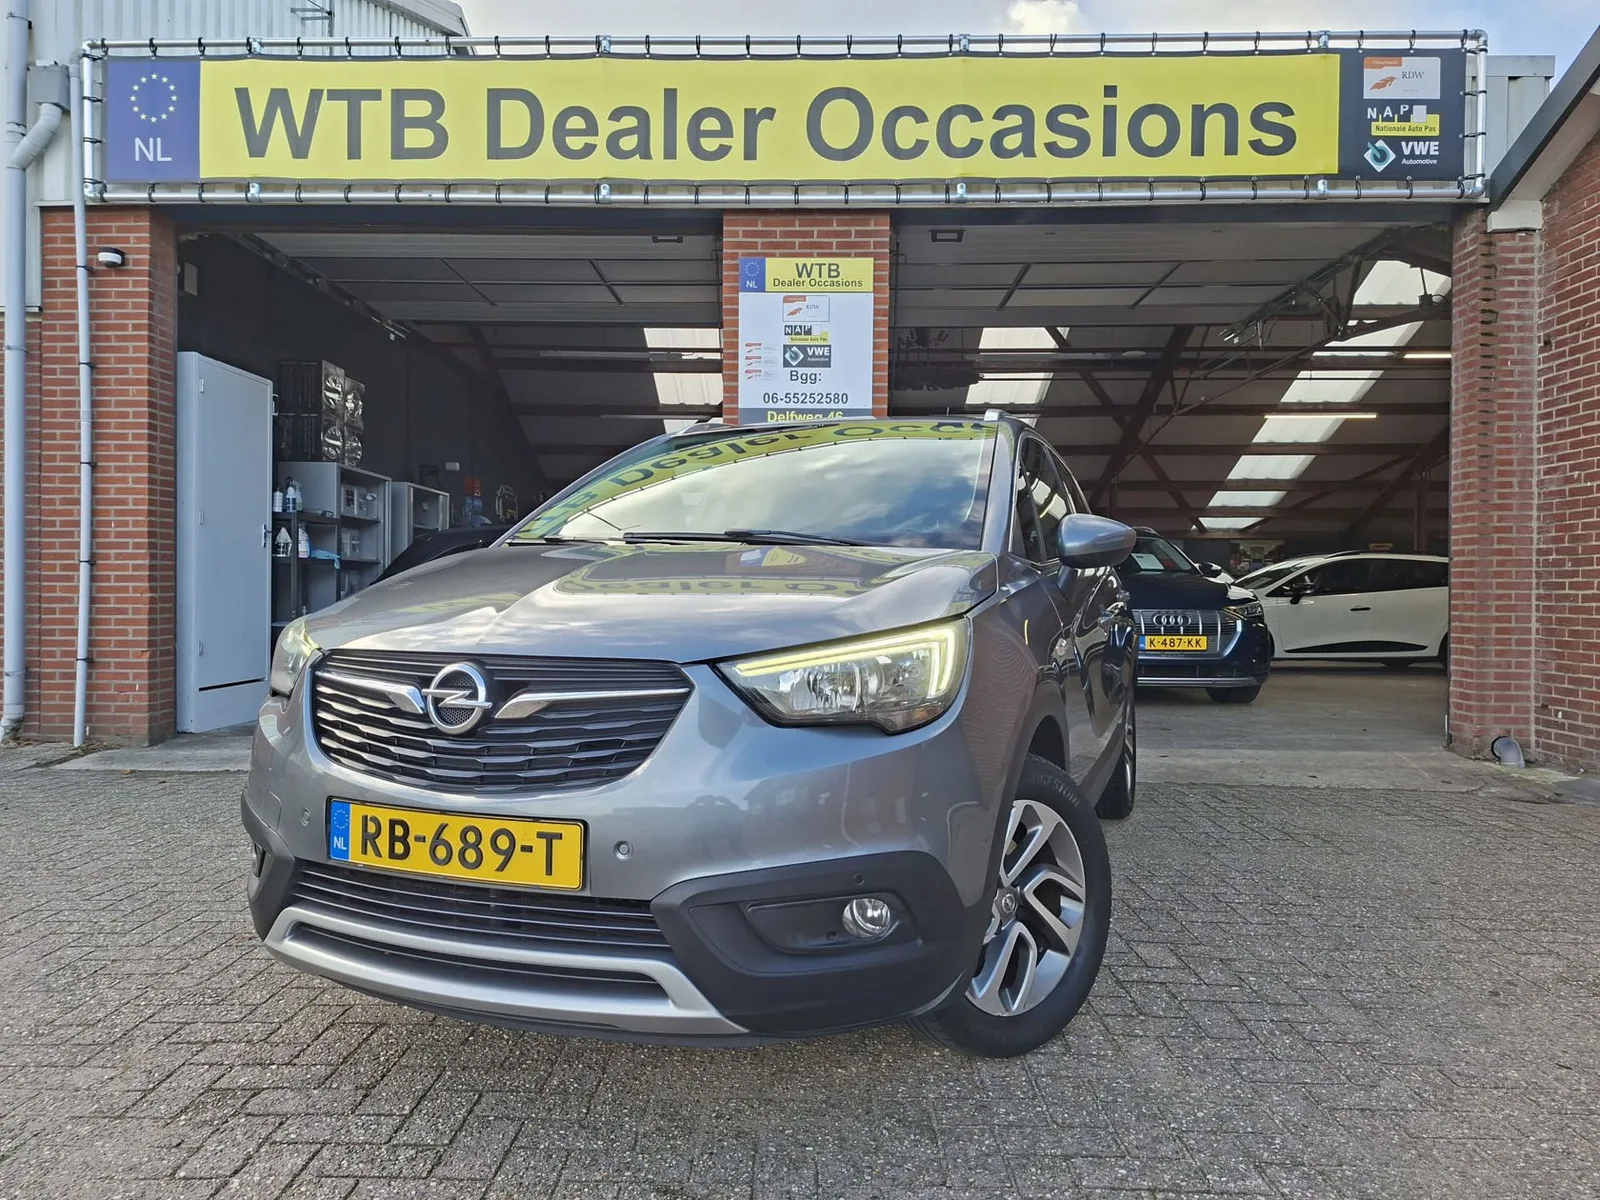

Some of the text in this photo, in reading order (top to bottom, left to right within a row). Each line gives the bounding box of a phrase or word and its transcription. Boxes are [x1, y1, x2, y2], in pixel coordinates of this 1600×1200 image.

[1401, 71, 1425, 80] RDW
[234, 84, 1297, 162] WTB Dealer Occasions
[1375, 124, 1437, 133] Nationale Auto Pas
[134, 137, 173, 162] NL
[1401, 141, 1440, 155] VWE
[795, 262, 841, 278] WTB
[746, 280, 758, 289] NL
[772, 278, 863, 287] Dealer Occasions
[806, 346, 830, 356] VWE
[789, 370, 822, 384] Bgg:
[763, 393, 849, 404] 06-55252580
[1149, 637, 1203, 648] K-487-KK
[333, 836, 347, 850] NL
[360, 813, 563, 877] RB-689-T
